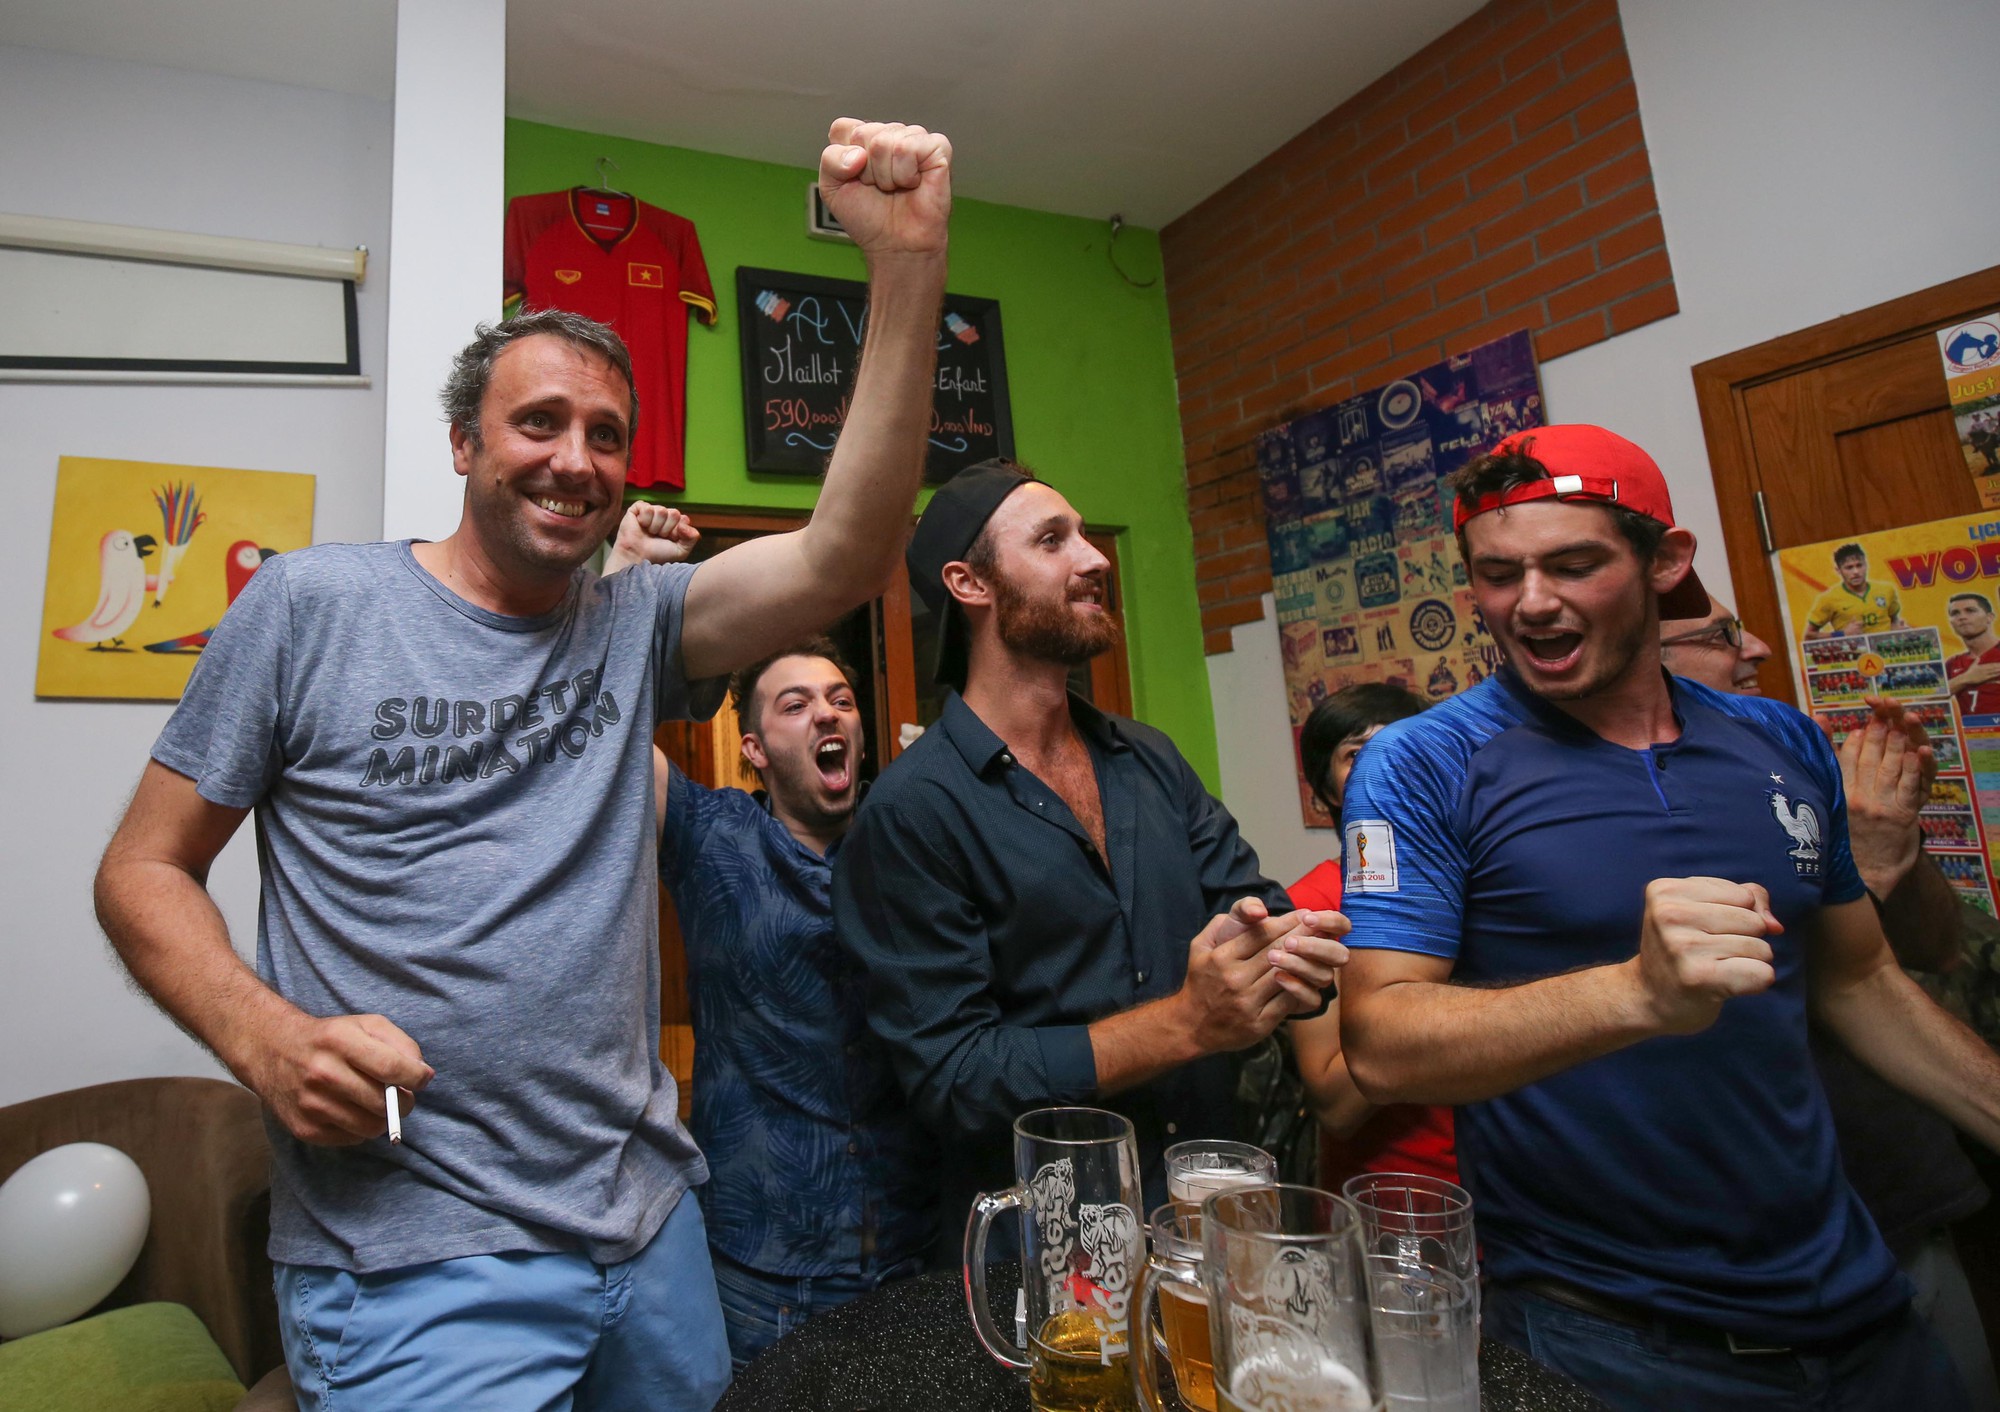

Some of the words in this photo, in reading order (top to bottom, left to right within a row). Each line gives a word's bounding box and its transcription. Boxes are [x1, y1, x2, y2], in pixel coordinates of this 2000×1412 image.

[764, 334, 843, 384] Maillot
[939, 366, 987, 400] Enfant
[1953, 377, 1996, 399] Just
[1865, 659, 1877, 671] A
[1968, 690, 1978, 713] 7
[359, 690, 621, 787] MINATION
